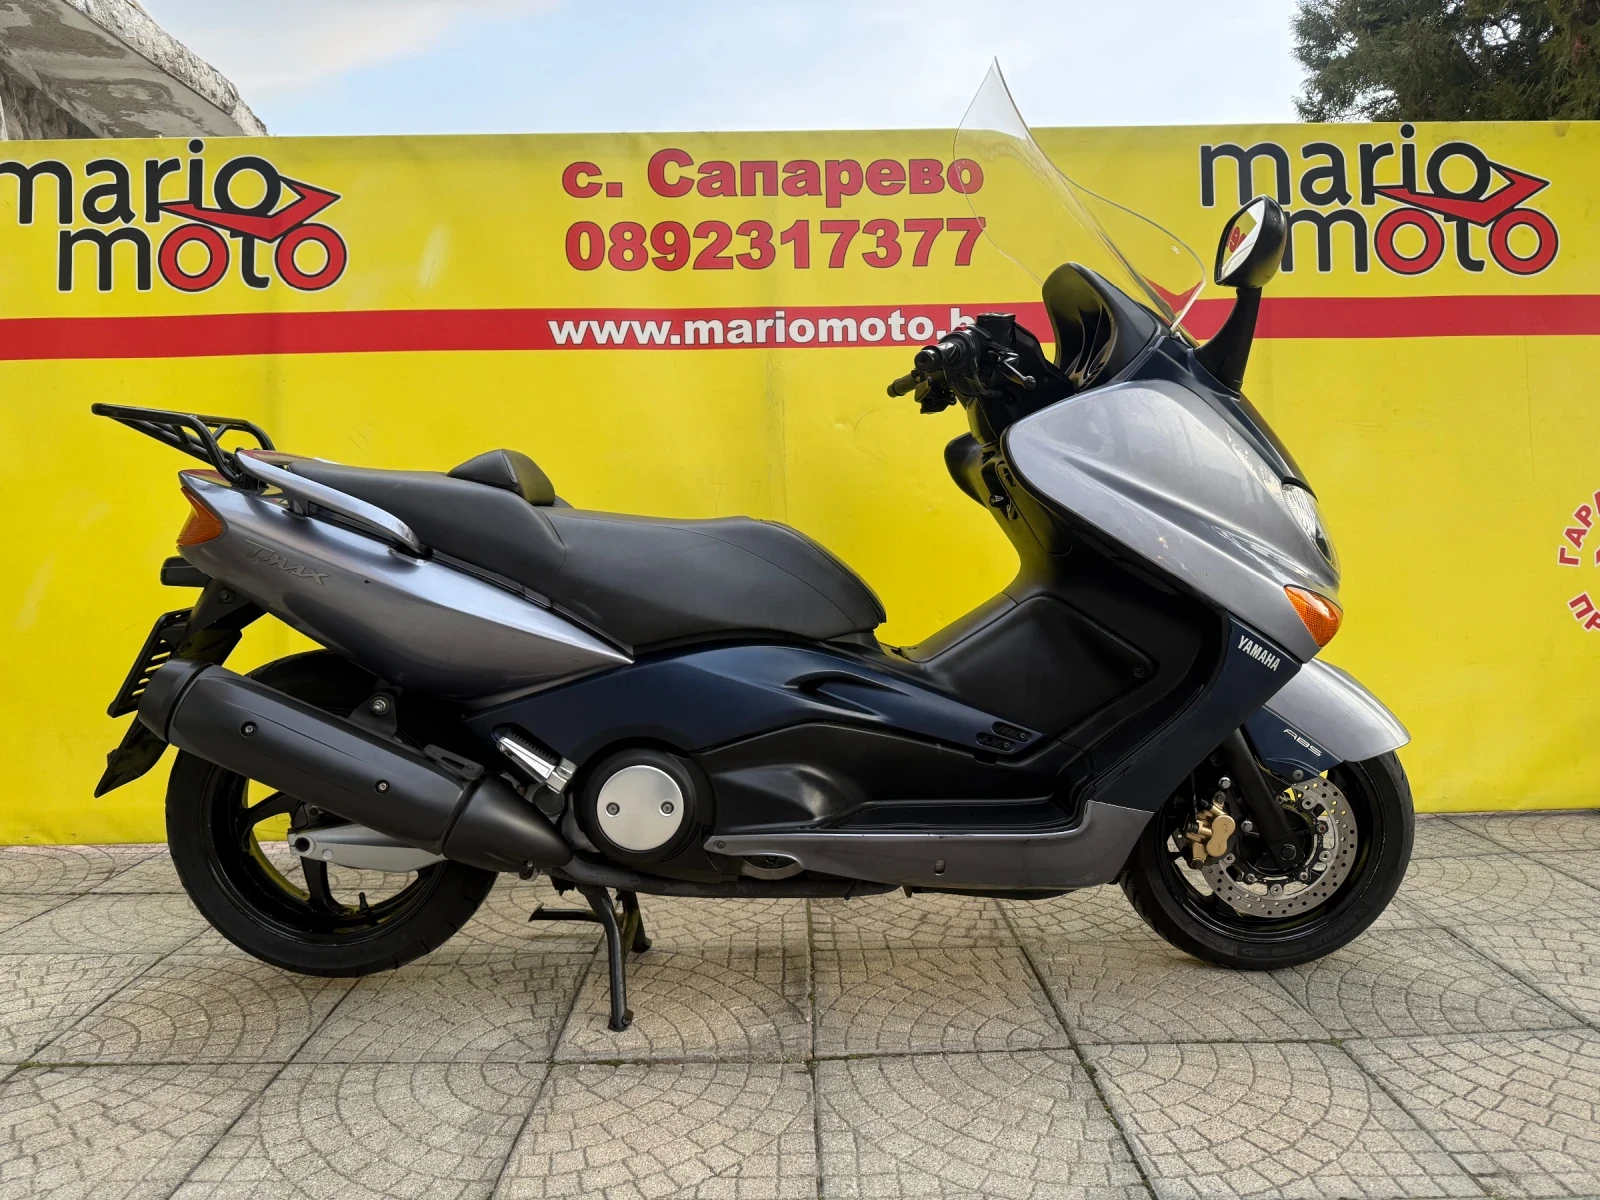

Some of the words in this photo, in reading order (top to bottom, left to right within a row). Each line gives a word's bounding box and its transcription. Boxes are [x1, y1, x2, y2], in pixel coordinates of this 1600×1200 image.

[0, 139, 281, 225] mario
[562, 161, 623, 198] с.
[647, 148, 985, 208] Сапарево
[1201, 124, 1491, 206] mario
[57, 223, 348, 292] moto
[565, 216, 987, 271] 0892317377
[1281, 207, 1560, 275] moto
[1236, 634, 1281, 672] YAMAHA
[1283, 728, 1322, 757] ABS
